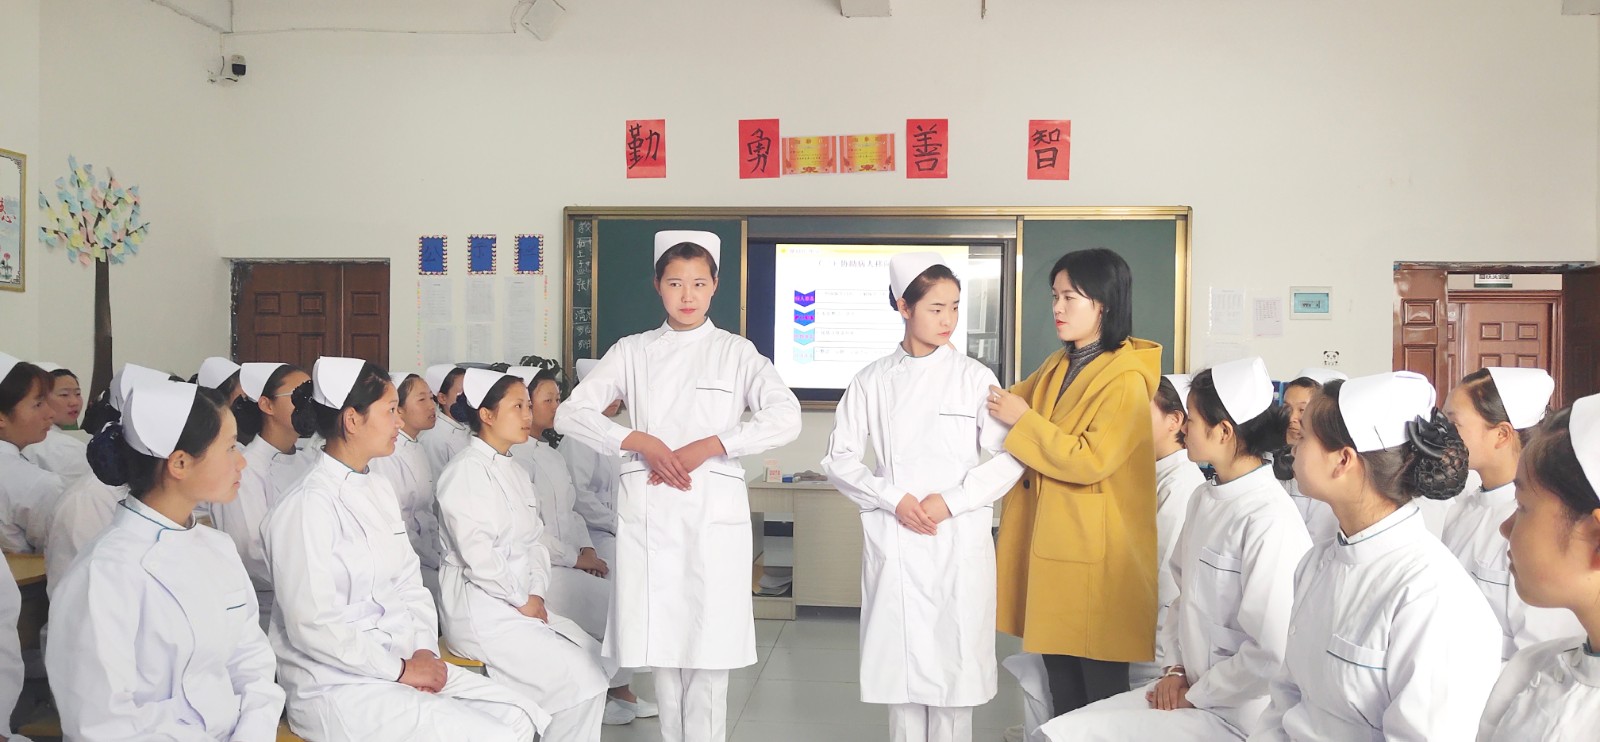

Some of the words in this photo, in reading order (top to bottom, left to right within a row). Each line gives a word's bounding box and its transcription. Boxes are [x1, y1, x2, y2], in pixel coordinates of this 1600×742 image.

[626, 123, 661, 170] 勤
[746, 128, 772, 174] 勇
[912, 124, 943, 172] 善
[1032, 128, 1061, 170] 智
[423, 245, 443, 262] 公
